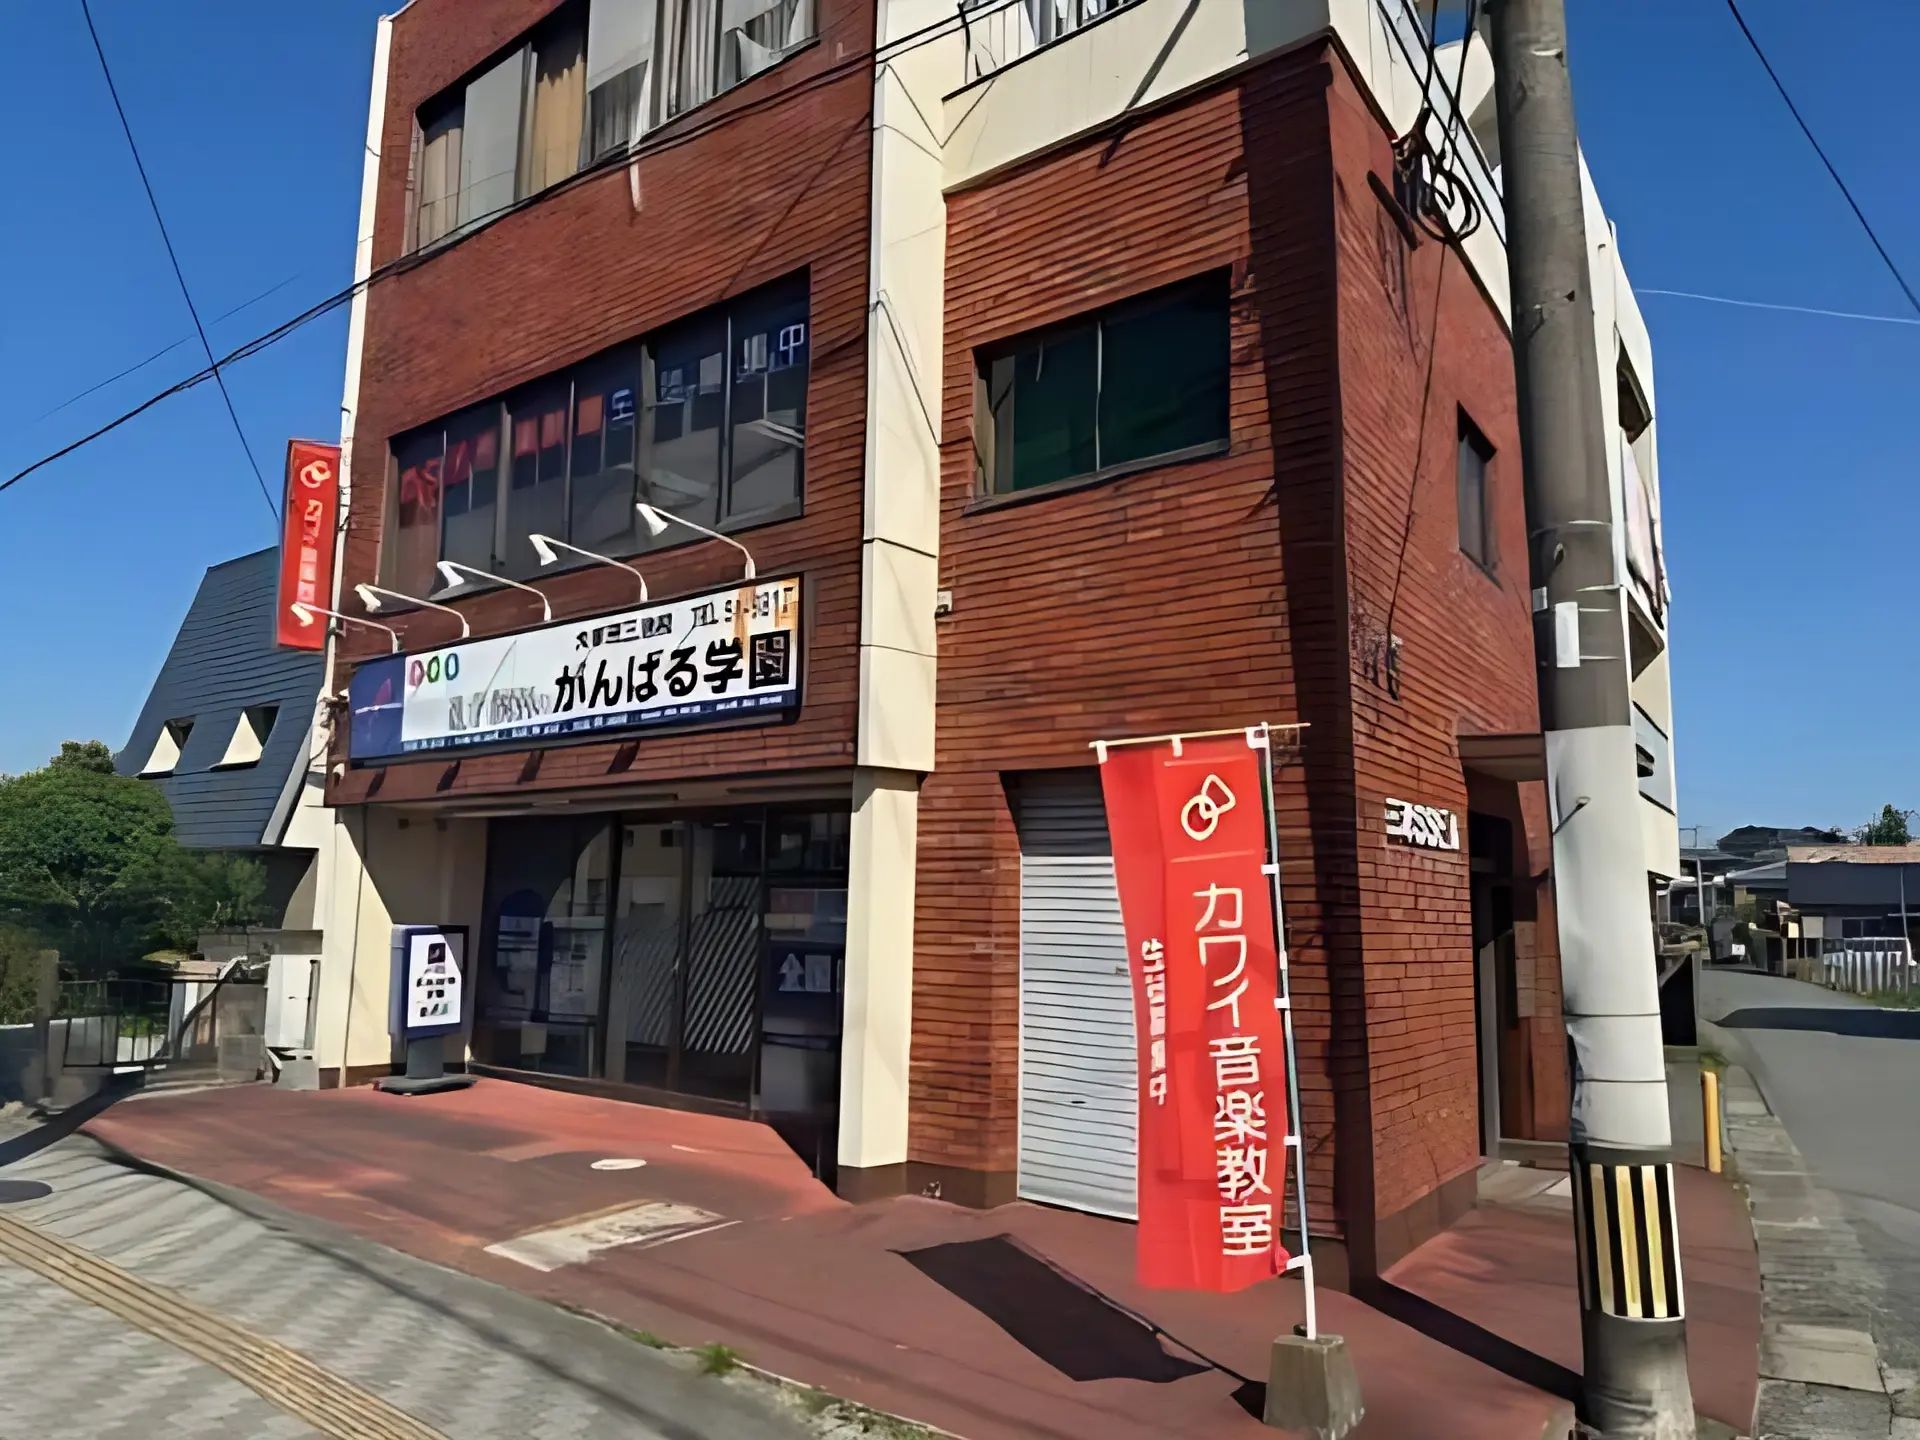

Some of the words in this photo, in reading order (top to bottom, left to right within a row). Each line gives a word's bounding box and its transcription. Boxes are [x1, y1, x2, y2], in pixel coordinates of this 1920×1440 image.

[1193, 882, 1273, 1256] カワイ音楽教室
